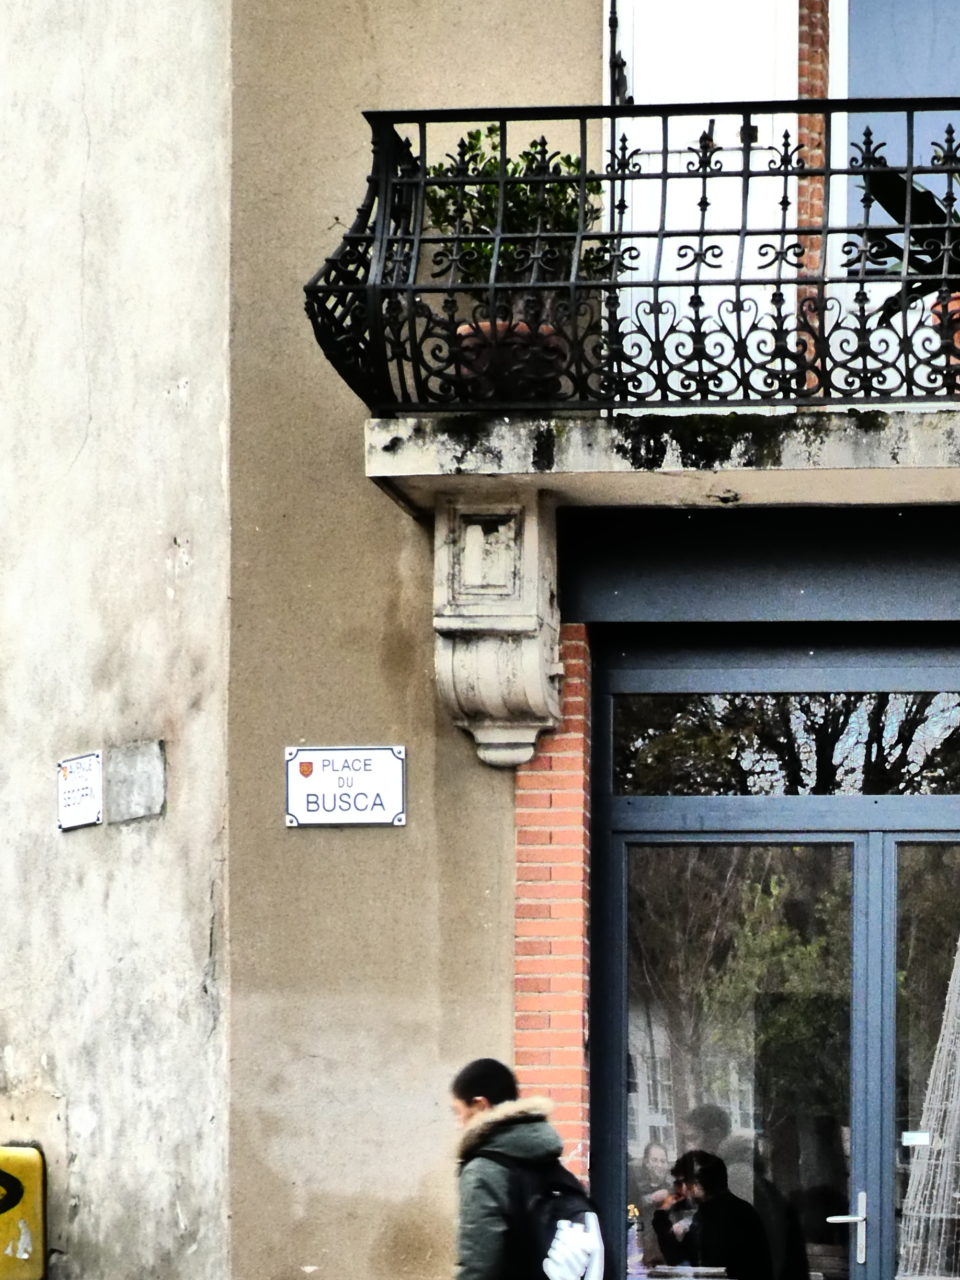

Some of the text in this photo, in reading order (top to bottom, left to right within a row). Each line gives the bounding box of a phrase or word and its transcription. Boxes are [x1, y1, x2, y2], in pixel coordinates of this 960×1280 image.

[322, 758, 373, 772] PLACE
[337, 776, 354, 788] DU
[306, 792, 386, 812] BUSCA
